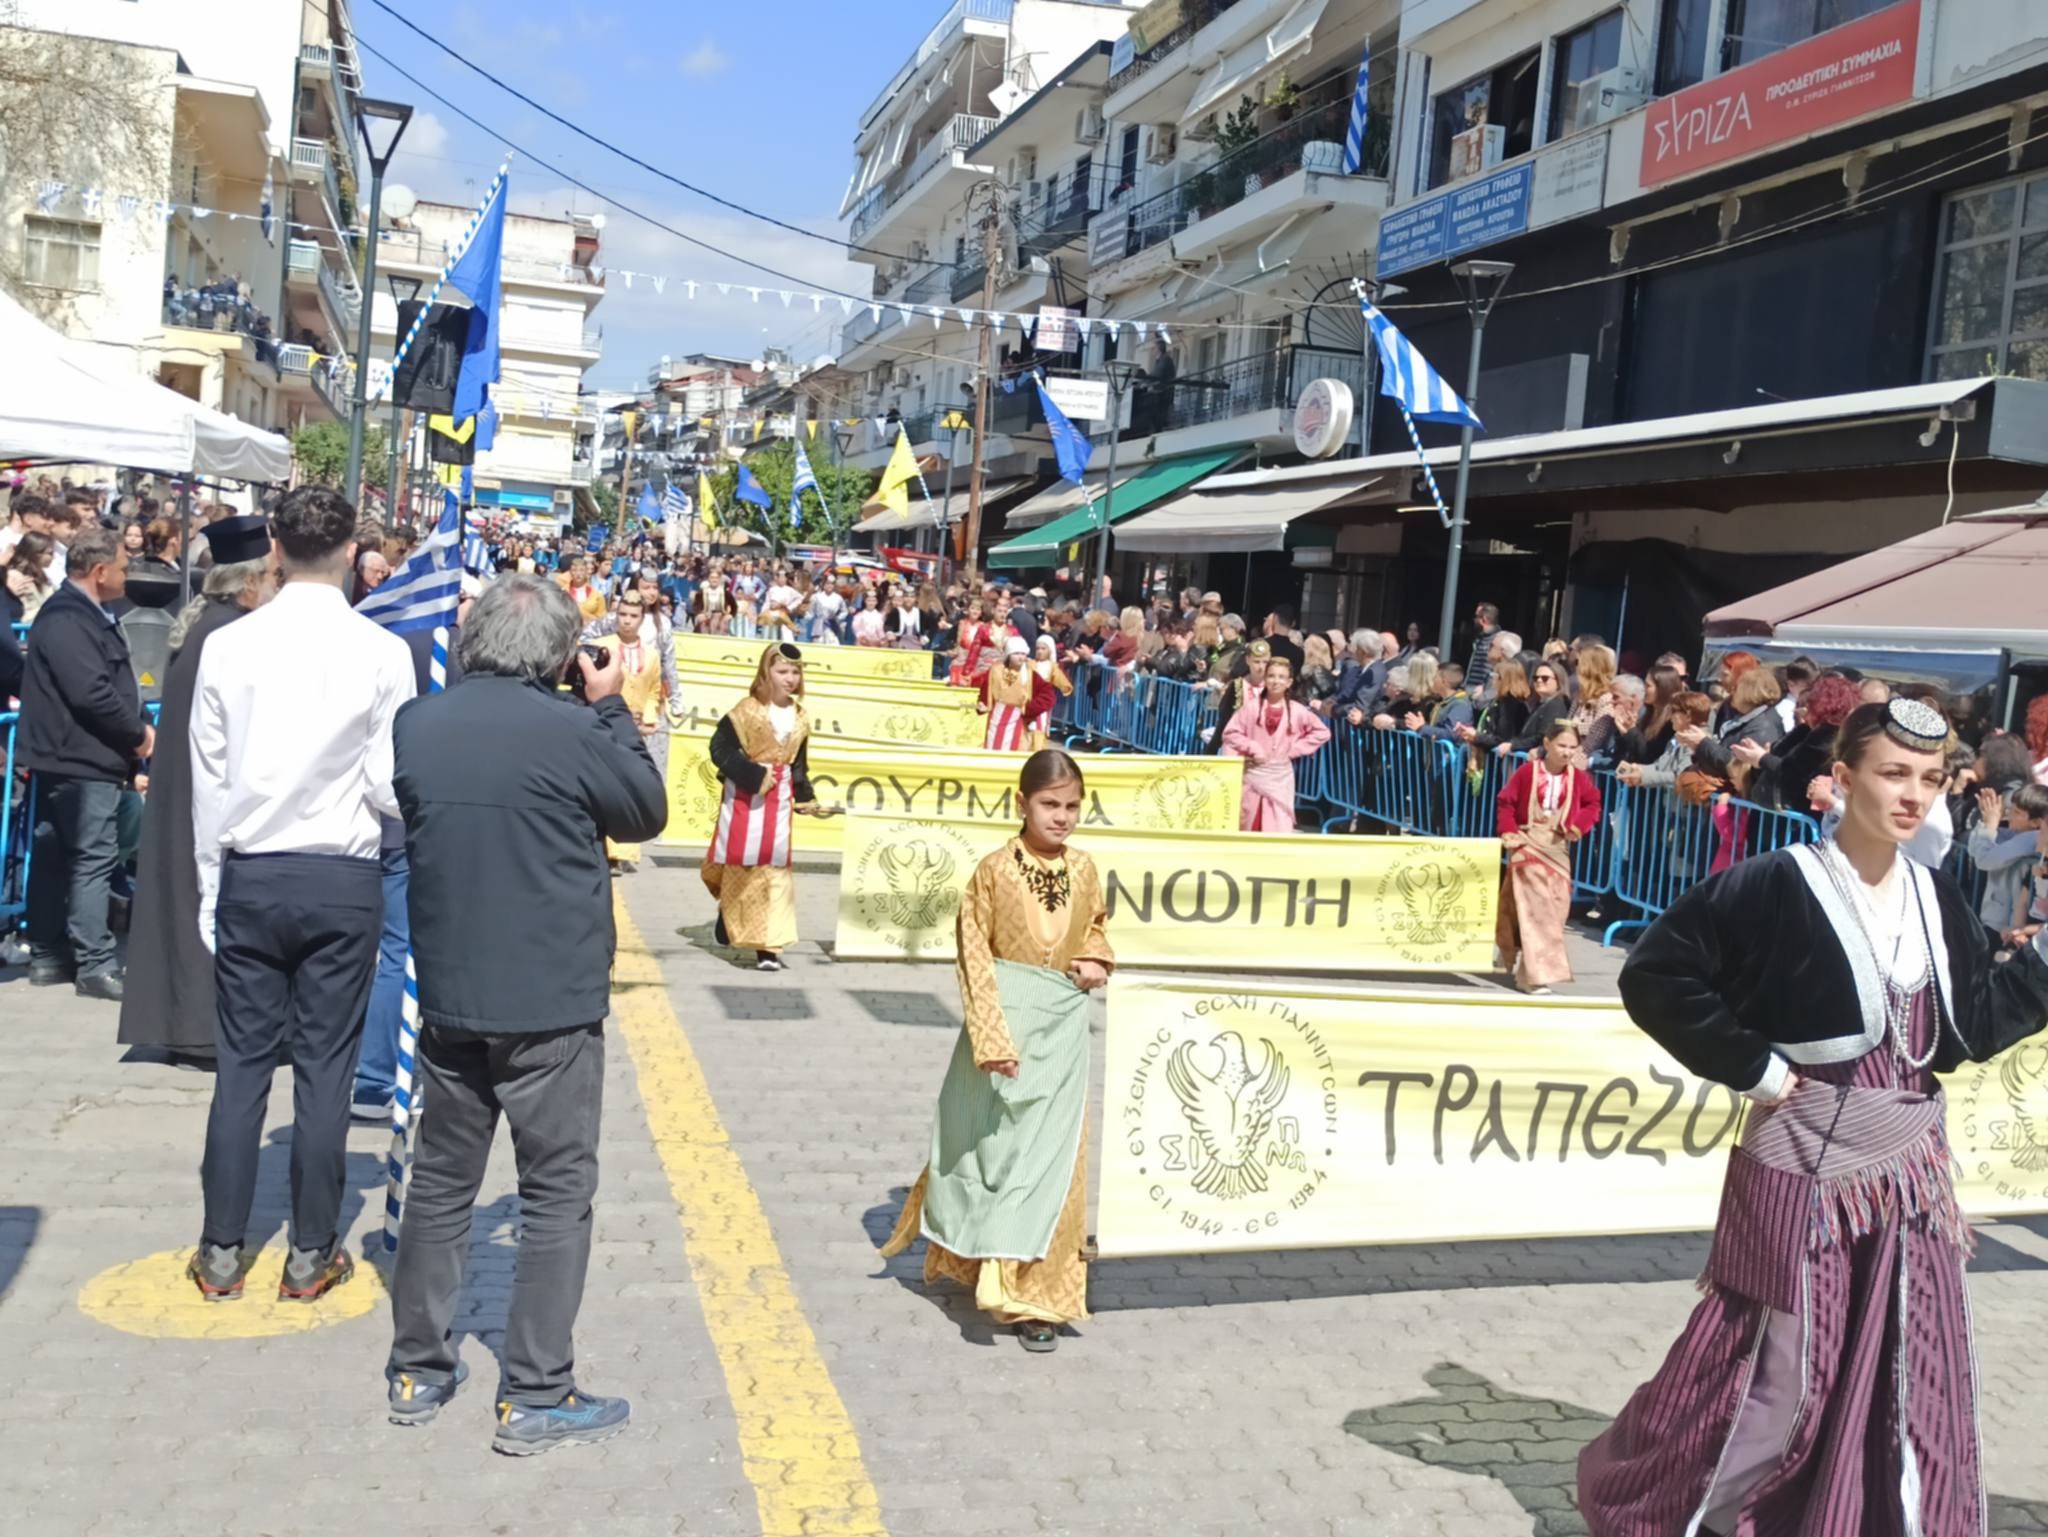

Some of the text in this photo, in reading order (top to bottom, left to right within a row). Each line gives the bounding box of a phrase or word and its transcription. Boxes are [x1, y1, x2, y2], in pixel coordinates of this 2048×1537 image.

[1765, 39, 1902, 102] ΠΡΟΟΔΕΥΤΙΚΗ ΣΥΜΜΑΧΙΑ
[1654, 92, 1752, 162] ΣΥΡΙΖΑ
[1105, 869, 1351, 928] ΝΩΠΗ
[1358, 1063, 1741, 1167] ΤΡΑΠΕΖΟ
[1180, 1210, 1224, 1236] 1942
